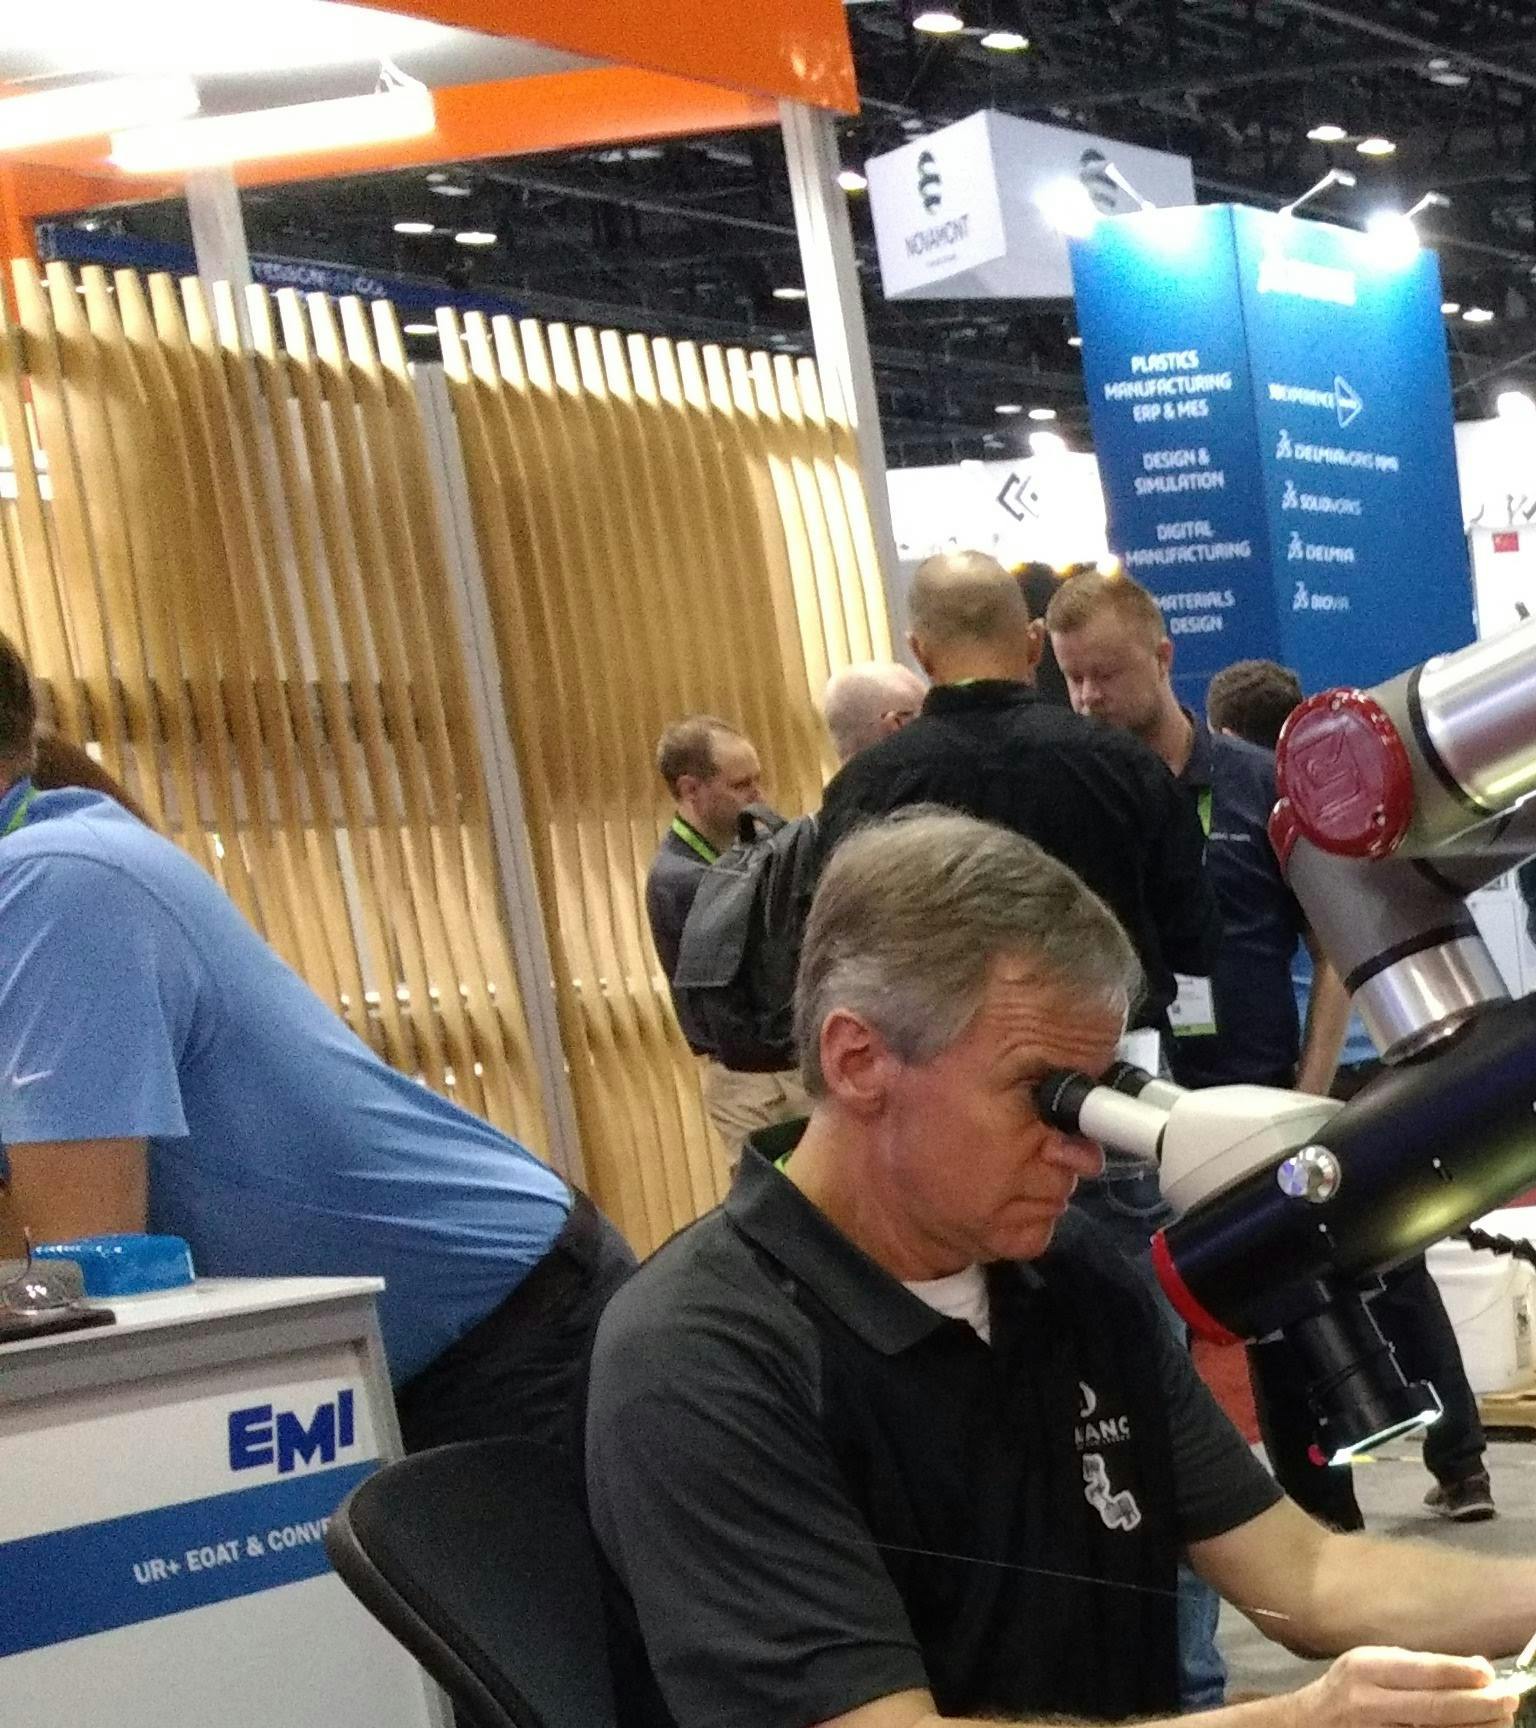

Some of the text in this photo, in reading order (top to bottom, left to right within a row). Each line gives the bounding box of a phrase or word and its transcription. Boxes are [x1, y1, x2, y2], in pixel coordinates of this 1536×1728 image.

[1130, 350, 1199, 374] PLASTICS
[1104, 372, 1233, 400] MANUFACTURING
[1133, 399, 1209, 422] ERP & MES
[1142, 447, 1210, 470] DESIGN &
[1134, 470, 1225, 495] SIMULATION
[1157, 520, 1215, 541] DIGITAL
[1125, 540, 1251, 566] MANUFACTURING
[1170, 614, 1224, 634] DESIGN
[228, 1388, 355, 1474] EMI
[131, 1557, 182, 1585] UR+
[185, 1539, 241, 1572] EOAT
[245, 1535, 266, 1557] &
